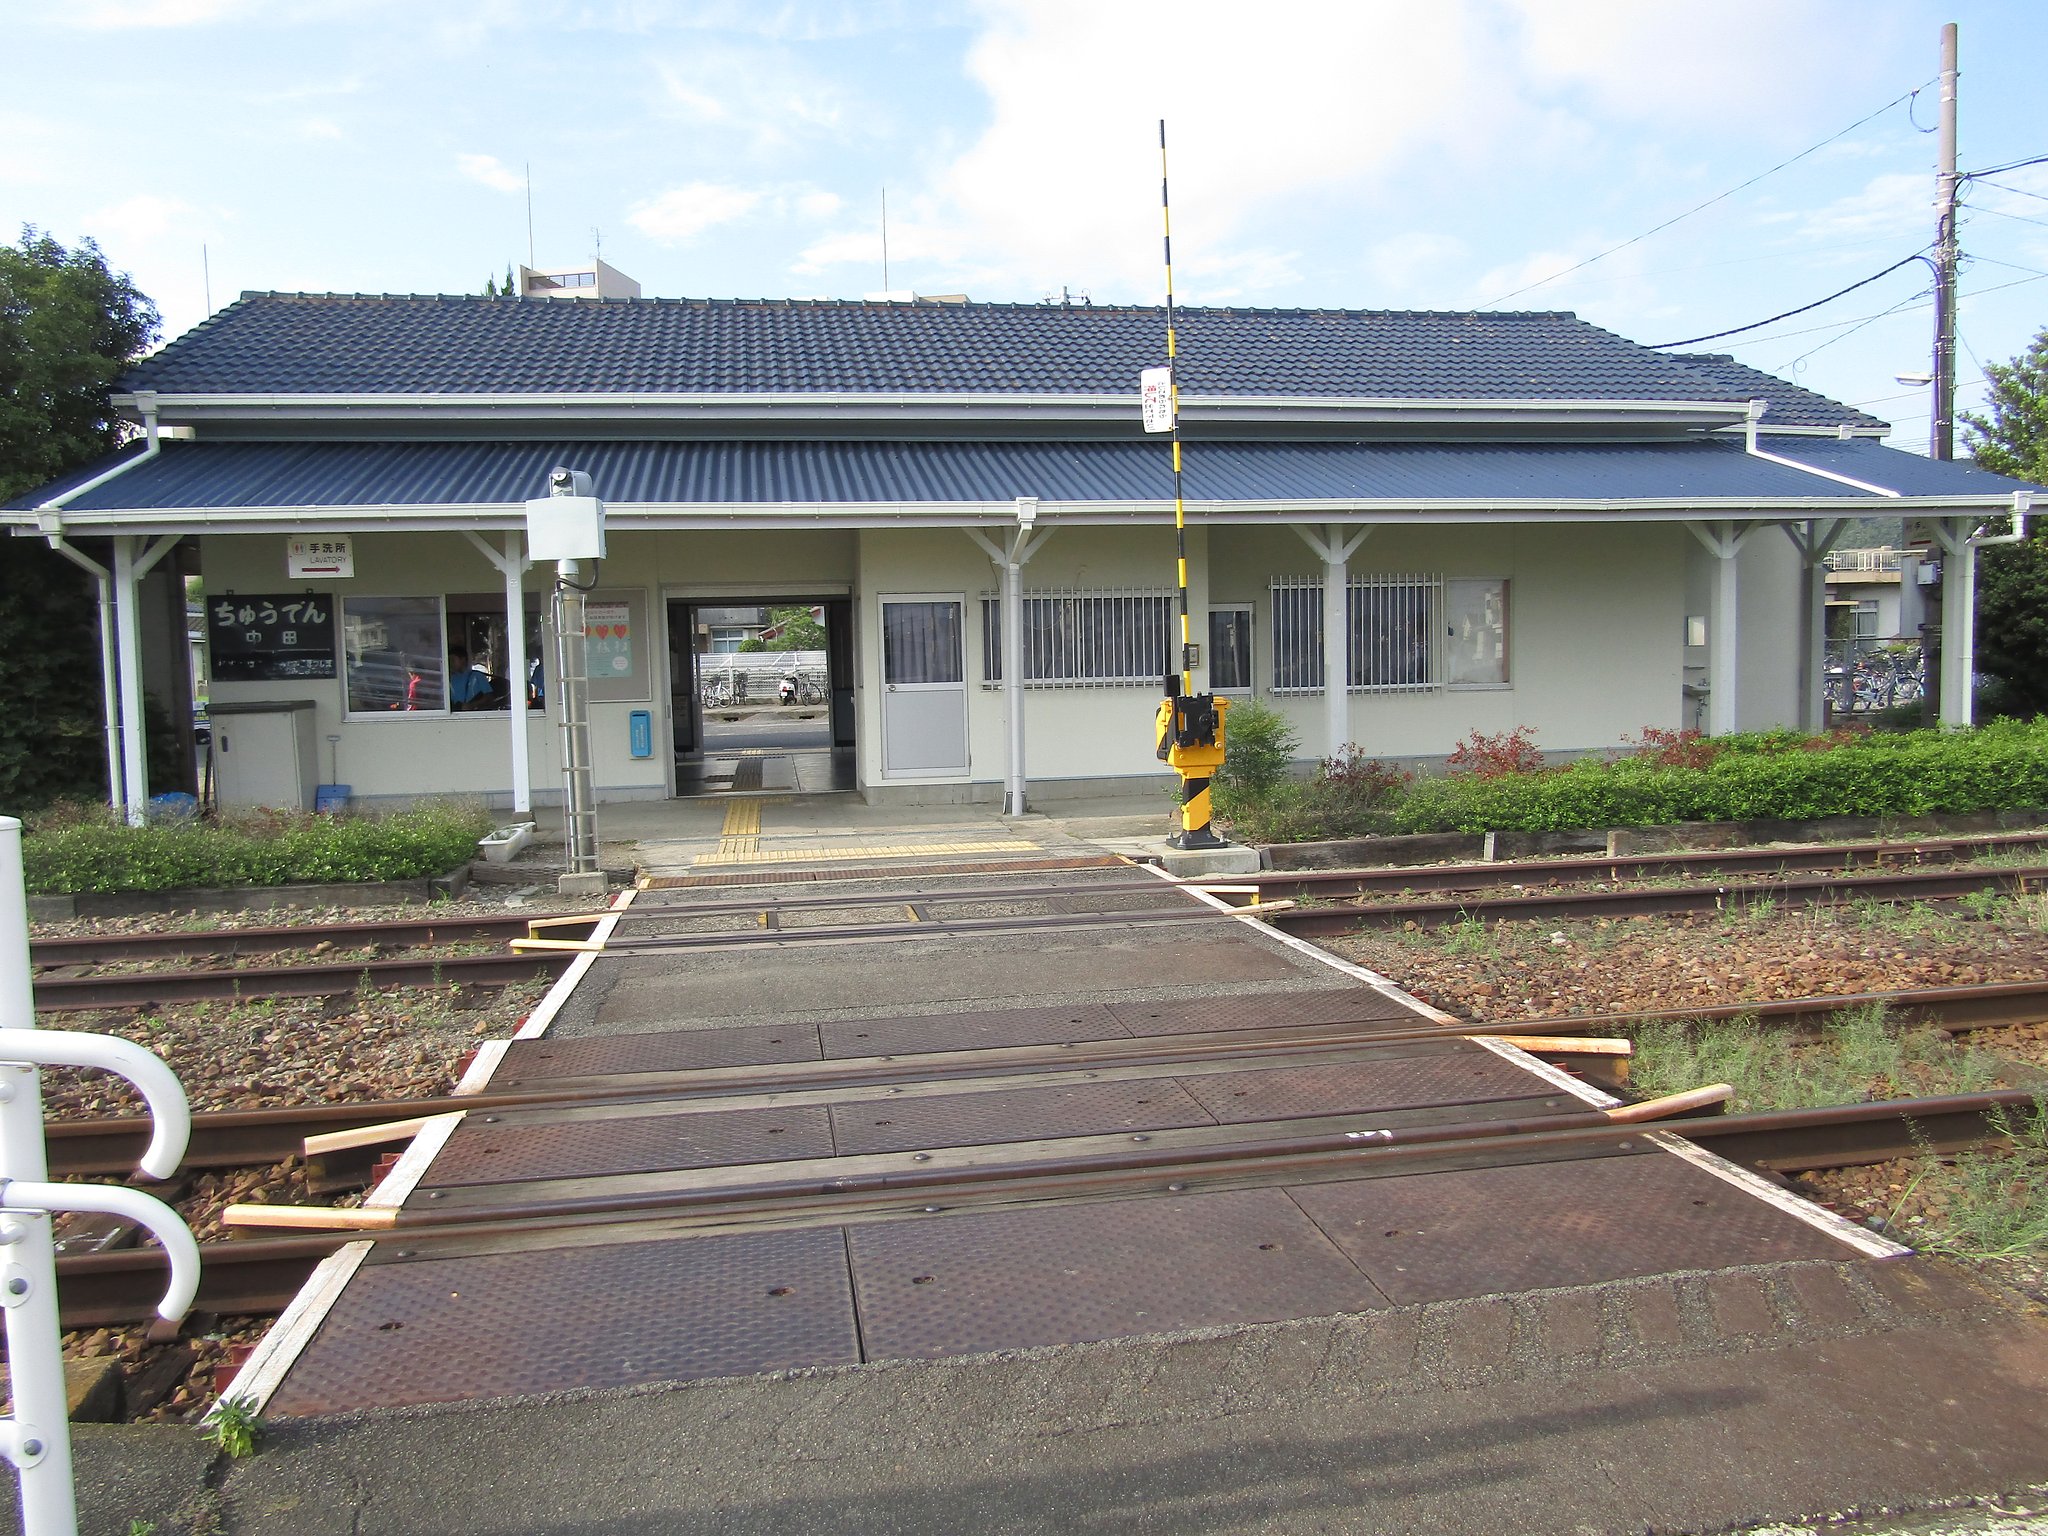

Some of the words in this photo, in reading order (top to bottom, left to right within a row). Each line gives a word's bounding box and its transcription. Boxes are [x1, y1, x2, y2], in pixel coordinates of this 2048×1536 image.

[310, 543, 346, 554] 手洗所
[310, 556, 347, 564] LAVATORY
[215, 601, 326, 626] ちゅうでん
